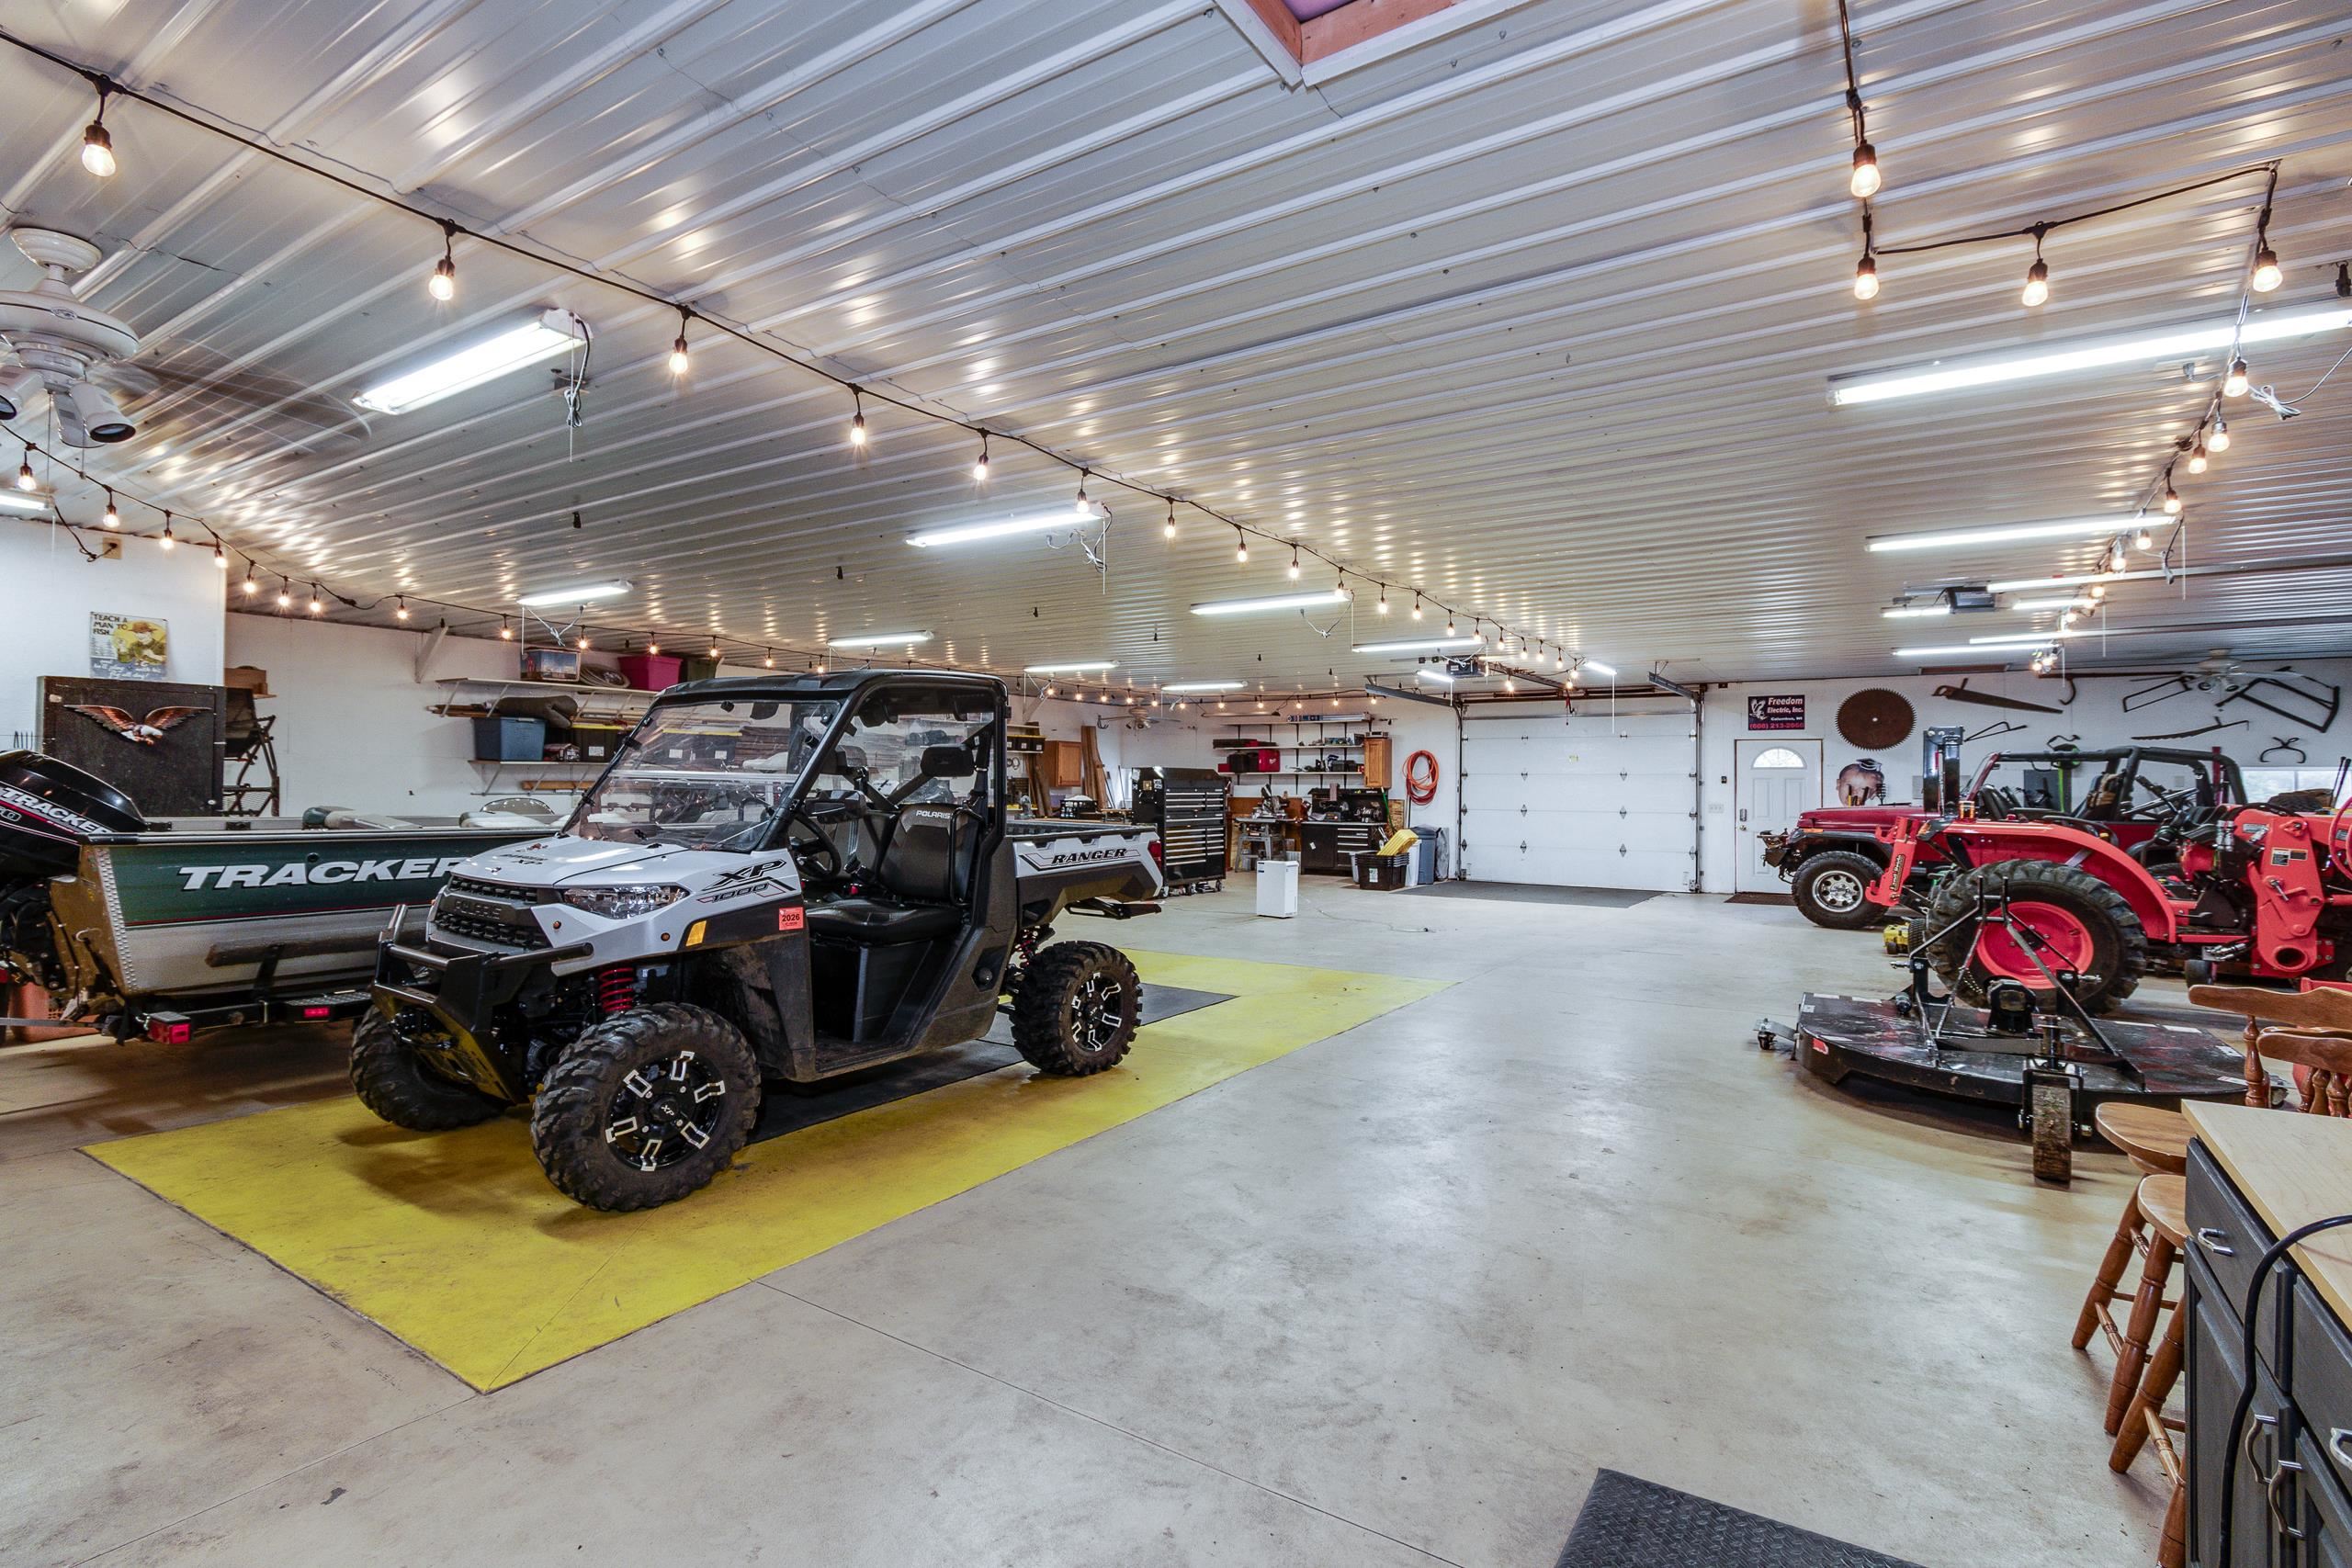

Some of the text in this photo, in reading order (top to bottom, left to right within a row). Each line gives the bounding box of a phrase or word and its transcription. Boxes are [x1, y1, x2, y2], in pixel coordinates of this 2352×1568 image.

[94, 614, 120, 623] TEACH
[94, 621, 114, 629] MAN
[1768, 697, 1803, 705] Freedom
[915, 809, 952, 819] POLARIS
[1051, 848, 1126, 865] RANGER
[702, 859, 786, 891] XP
[710, 883, 769, 903] 1000
[782, 913, 800, 921] 2026
[662, 1104, 674, 1116] XP
